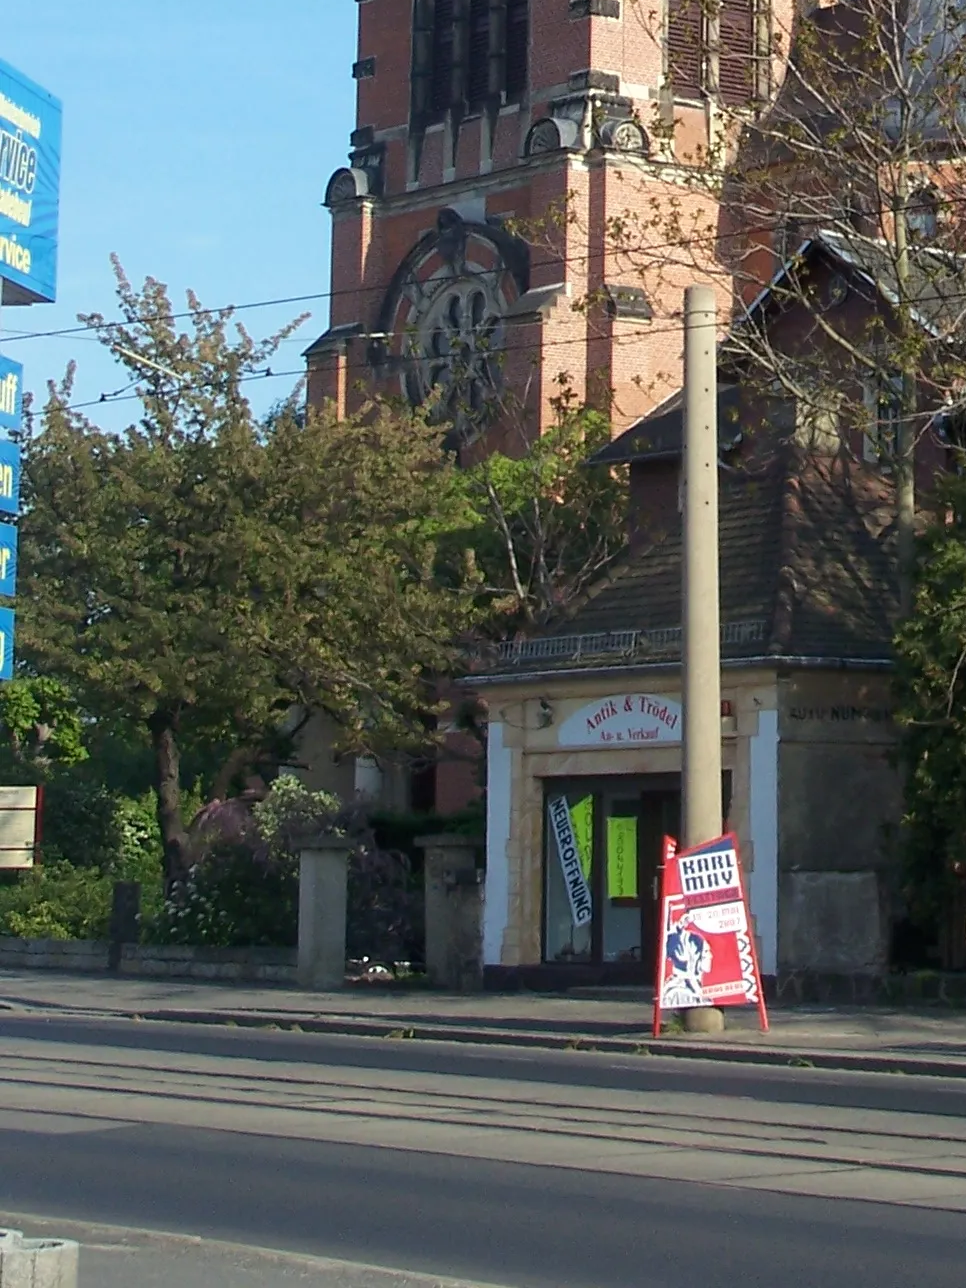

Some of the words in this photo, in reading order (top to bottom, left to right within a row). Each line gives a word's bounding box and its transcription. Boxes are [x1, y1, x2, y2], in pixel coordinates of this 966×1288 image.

[586, 699, 618, 730] Antik
[623, 695, 634, 712] &
[638, 695, 678, 730] Trödel
[627, 726, 660, 741] Verkauf
[682, 853, 734, 875] KARL
[685, 869, 733, 892] MAY
